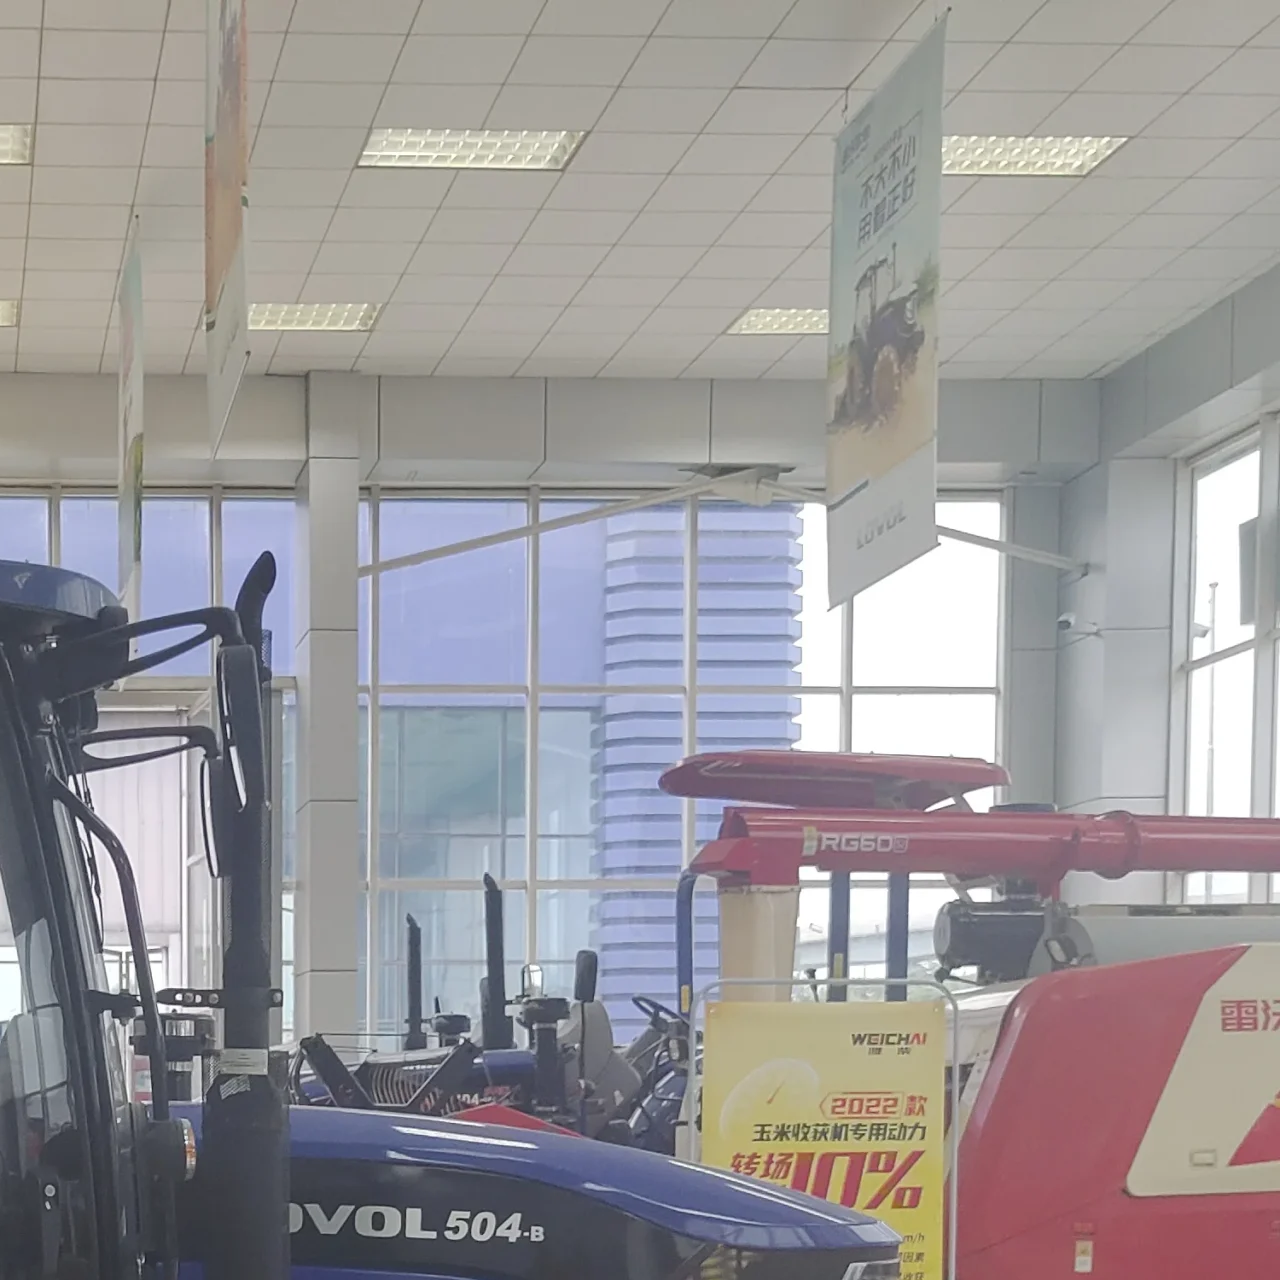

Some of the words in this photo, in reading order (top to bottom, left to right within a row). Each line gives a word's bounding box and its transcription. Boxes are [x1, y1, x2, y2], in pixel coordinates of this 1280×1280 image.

[852, 1033, 928, 1046] WEICHAI
[830, 1097, 899, 1115] 2022
[752, 1122, 927, 1142] 玉米收获机专用动力
[444, 1210, 545, 1242] 504-B
